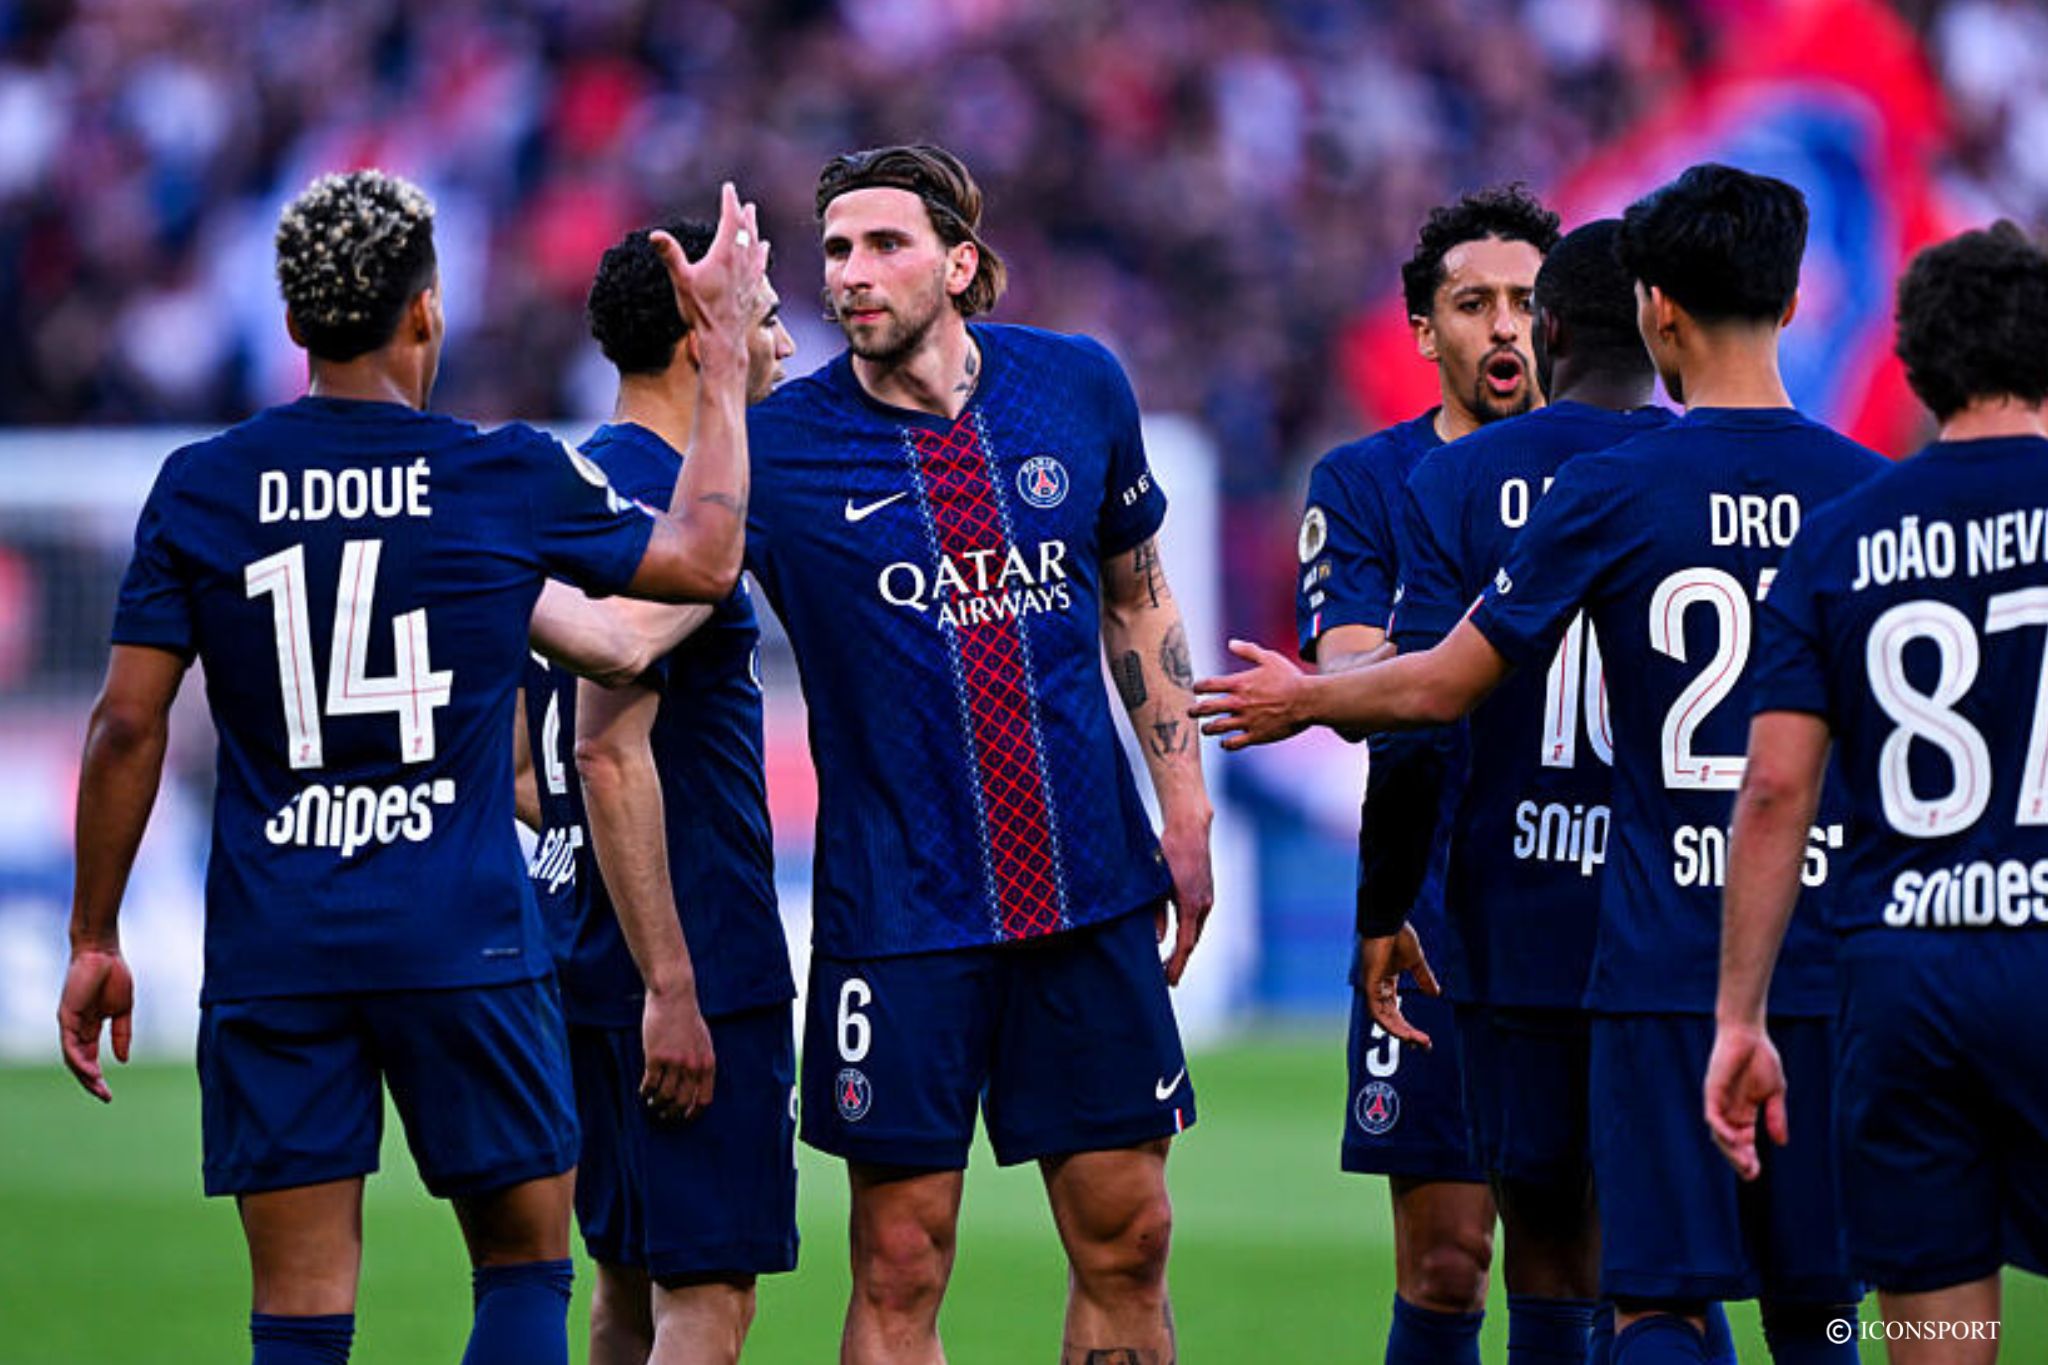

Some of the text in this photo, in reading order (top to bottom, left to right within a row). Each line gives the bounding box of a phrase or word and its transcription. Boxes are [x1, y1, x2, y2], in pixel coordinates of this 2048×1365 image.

[259, 456, 432, 524] D.DOUÉ
[1711, 493, 1800, 548] DRO
[878, 540, 1067, 611] QATAR
[1852, 508, 2048, 591] JOÃO NEV
[937, 583, 1071, 630] AIRWAYS
[245, 538, 453, 769] 14
[1649, 567, 1778, 789] 2
[265, 782, 434, 857] snipes
[837, 978, 871, 1062] 6
